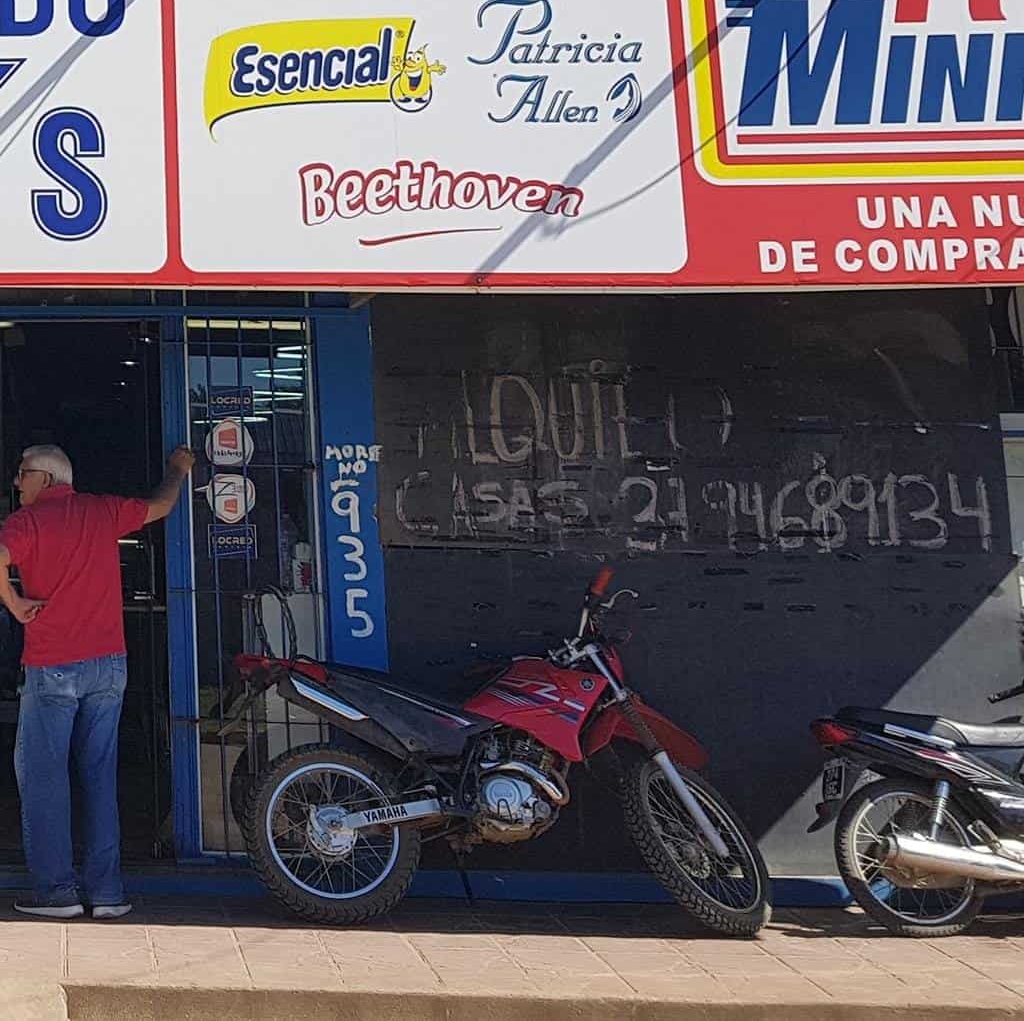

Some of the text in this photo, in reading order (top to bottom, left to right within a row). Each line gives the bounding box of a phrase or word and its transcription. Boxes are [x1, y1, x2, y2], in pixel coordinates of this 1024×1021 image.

[232, 27, 393, 97] Esencial
[487, 73, 599, 124] Allen
[298, 160, 585, 227] Beethoven
[856, 195, 957, 230] UNA
[758, 236, 1024, 273] DE COMPRA
[363, 805, 408, 823] YAMAHA
